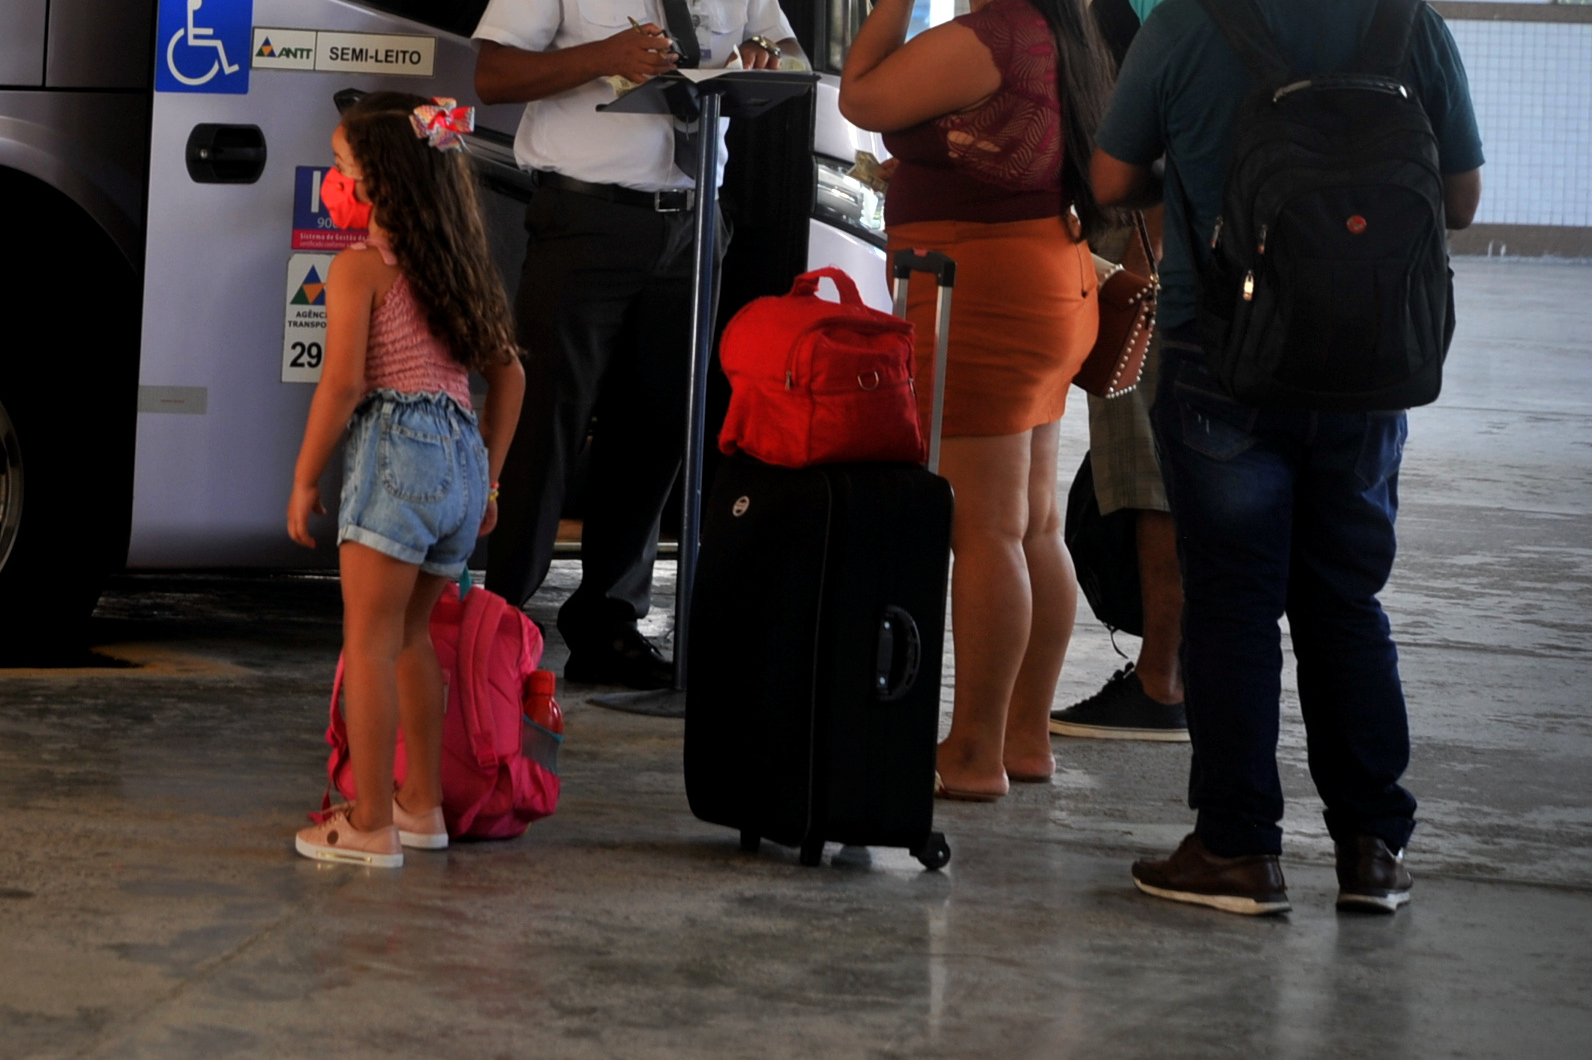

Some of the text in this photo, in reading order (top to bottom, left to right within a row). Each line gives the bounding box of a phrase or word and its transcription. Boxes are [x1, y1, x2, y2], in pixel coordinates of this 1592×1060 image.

[277, 47, 313, 60] ANTT
[328, 46, 422, 65] SEMI-LEITO
[299, 232, 325, 240] Sistema
[288, 320, 327, 329] TRANSPO
